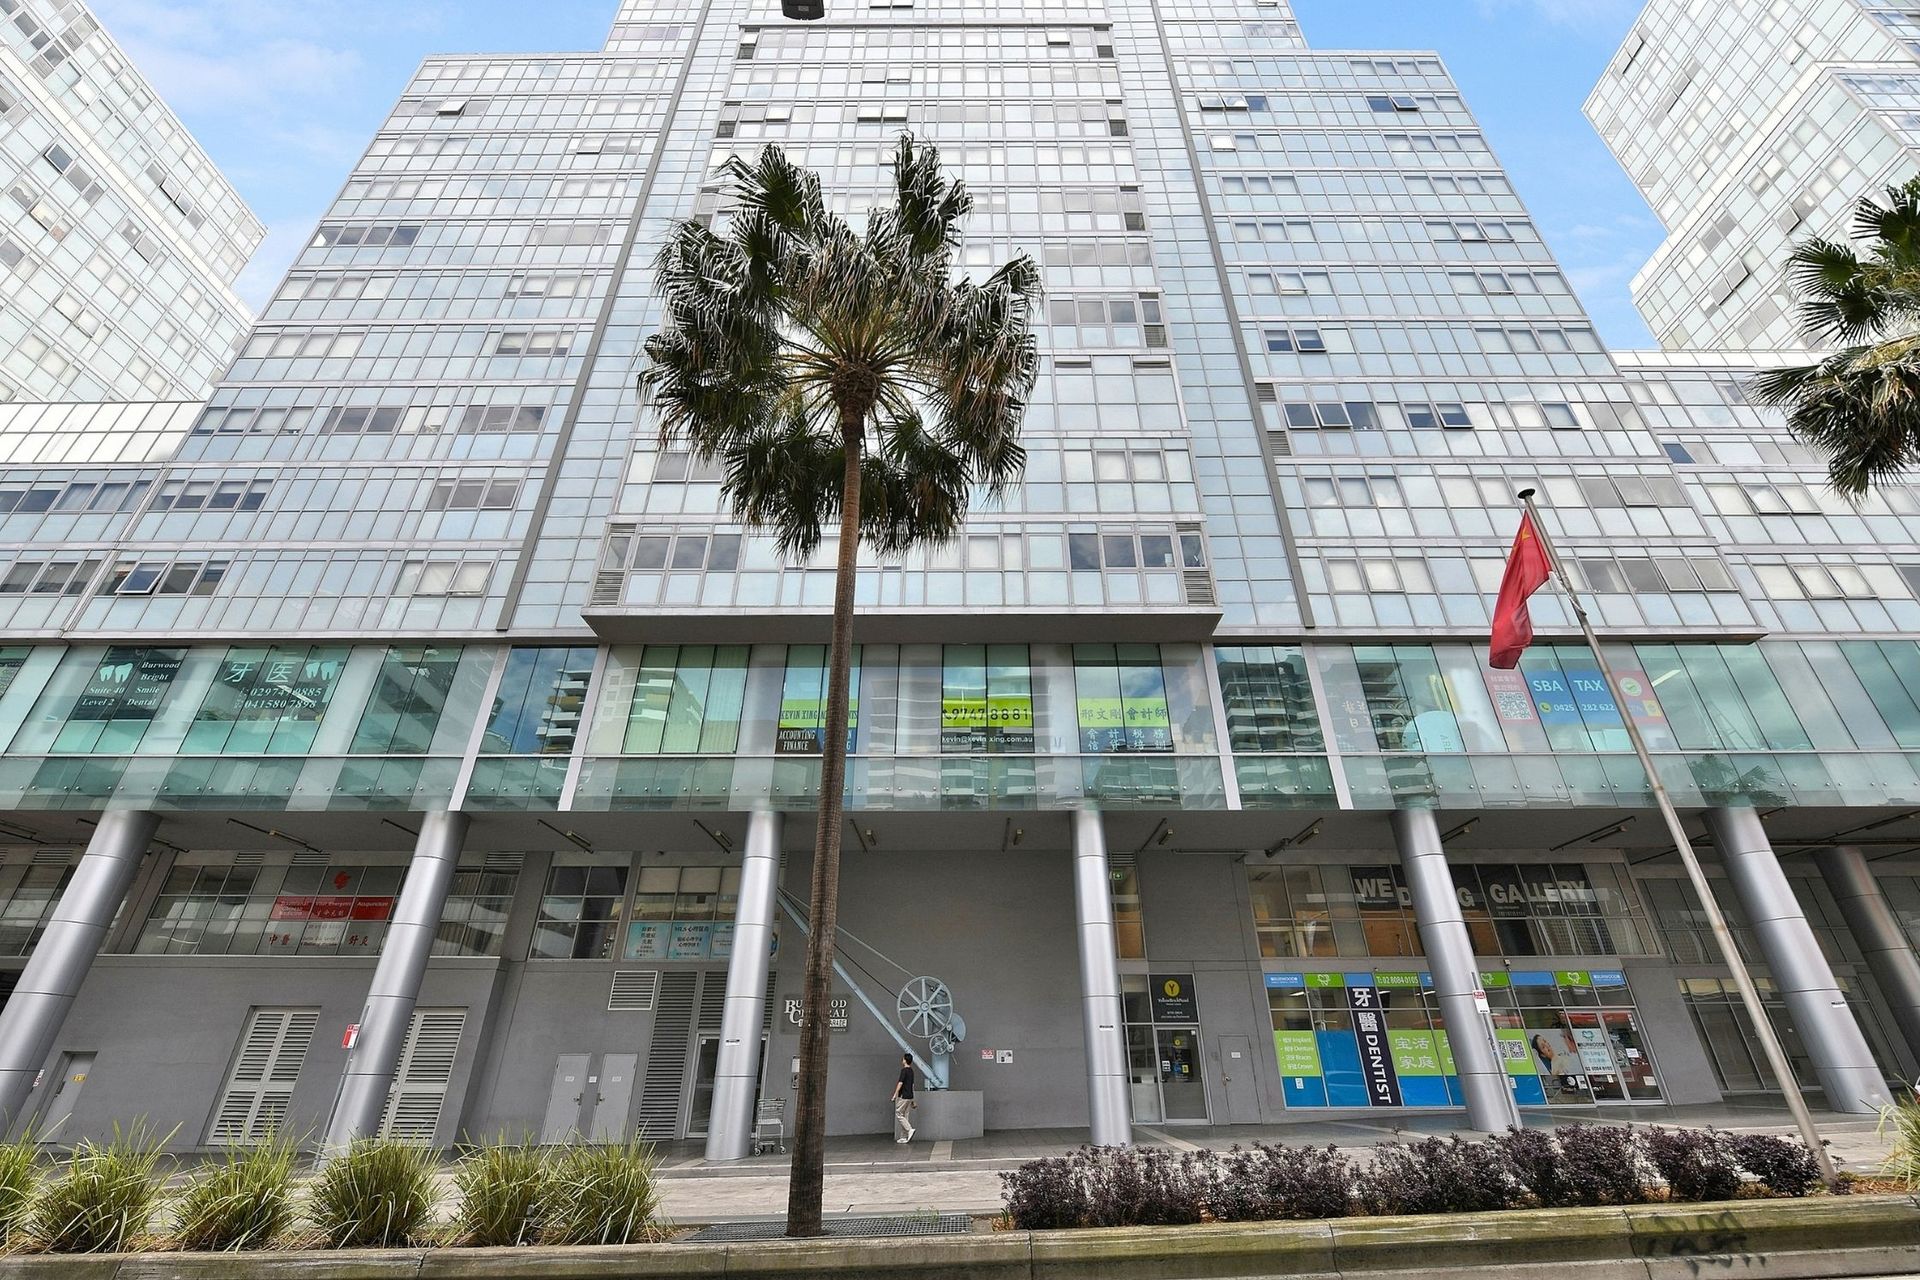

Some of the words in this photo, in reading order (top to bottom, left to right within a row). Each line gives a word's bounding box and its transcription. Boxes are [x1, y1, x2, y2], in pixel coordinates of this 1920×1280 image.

[141, 661, 181, 669] Burwood
[224, 661, 298, 683] 牙医
[140, 674, 169, 682] Bright
[136, 686, 160, 694] Smile
[1532, 679, 1564, 692] SBA
[1573, 679, 1605, 692] TAX
[126, 698, 157, 706] Dental
[1553, 704, 1575, 712] 0425
[1582, 703, 1598, 711] 282
[1599, 703, 1616, 711] 622
[780, 709, 801, 720] KEVIN
[801, 709, 819, 720] XING
[952, 708, 985, 720] 9747
[990, 708, 1029, 720] 8881
[779, 729, 816, 740] ACCOUNTING
[783, 741, 809, 751] FINANCE
[1489, 880, 1587, 904] GALLERY
[1366, 1035, 1392, 1104] DENTIST
